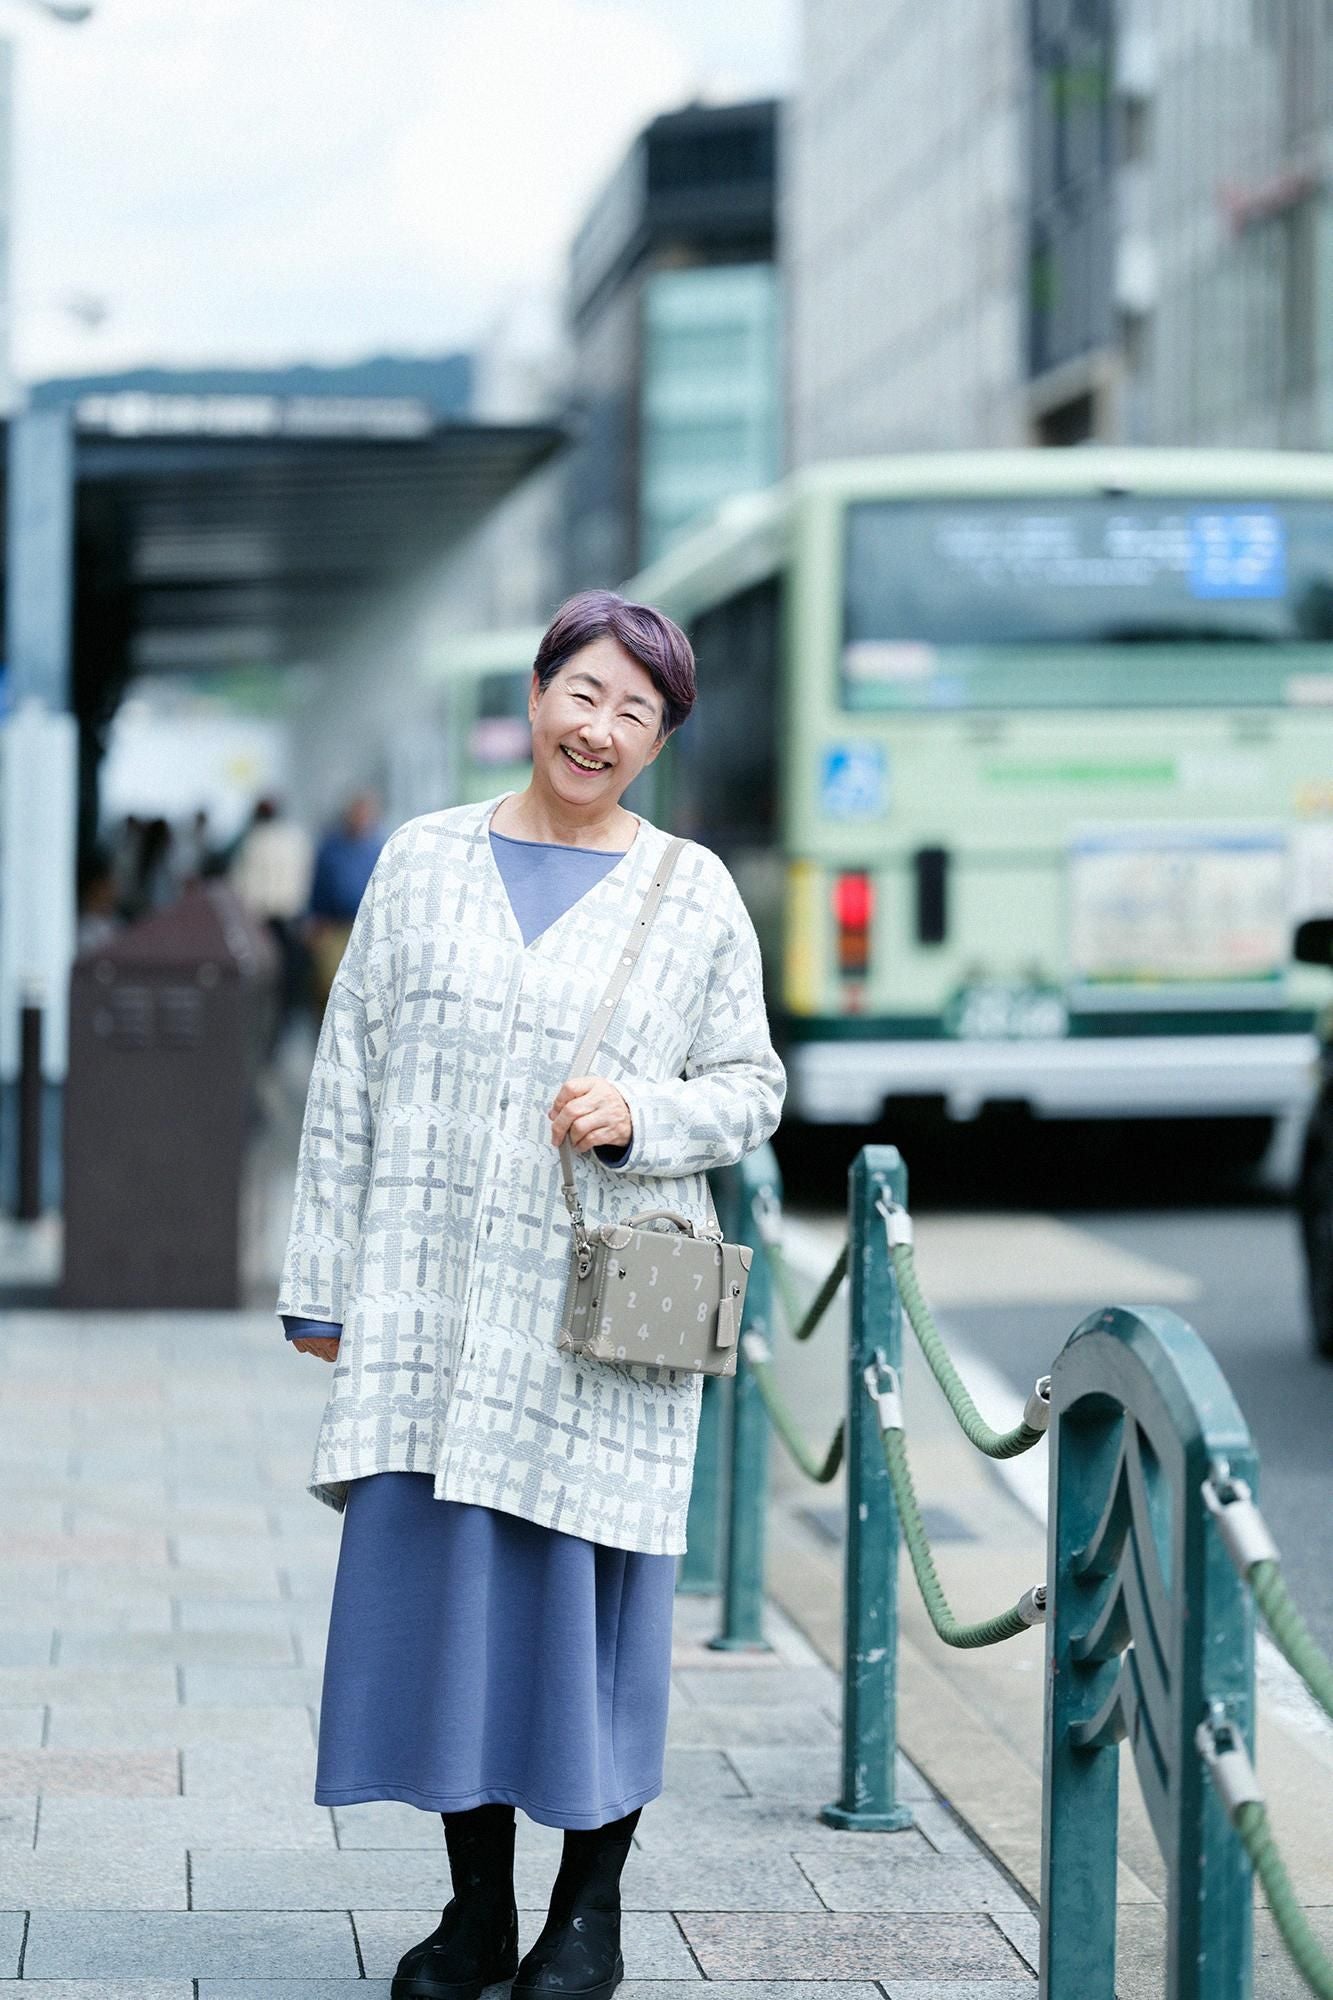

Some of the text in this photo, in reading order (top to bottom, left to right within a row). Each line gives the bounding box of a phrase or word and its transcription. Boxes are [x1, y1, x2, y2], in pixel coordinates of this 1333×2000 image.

[672, 1237, 683, 1256] 2
[606, 1258, 619, 1277] 9
[649, 1266, 658, 1286] 3
[693, 1274, 703, 1291] 7
[627, 1292, 637, 1309] 2
[662, 1297, 673, 1313] 0
[697, 1302, 708, 1323] 8
[601, 1317, 612, 1336] 5
[637, 1324, 649, 1341] 4
